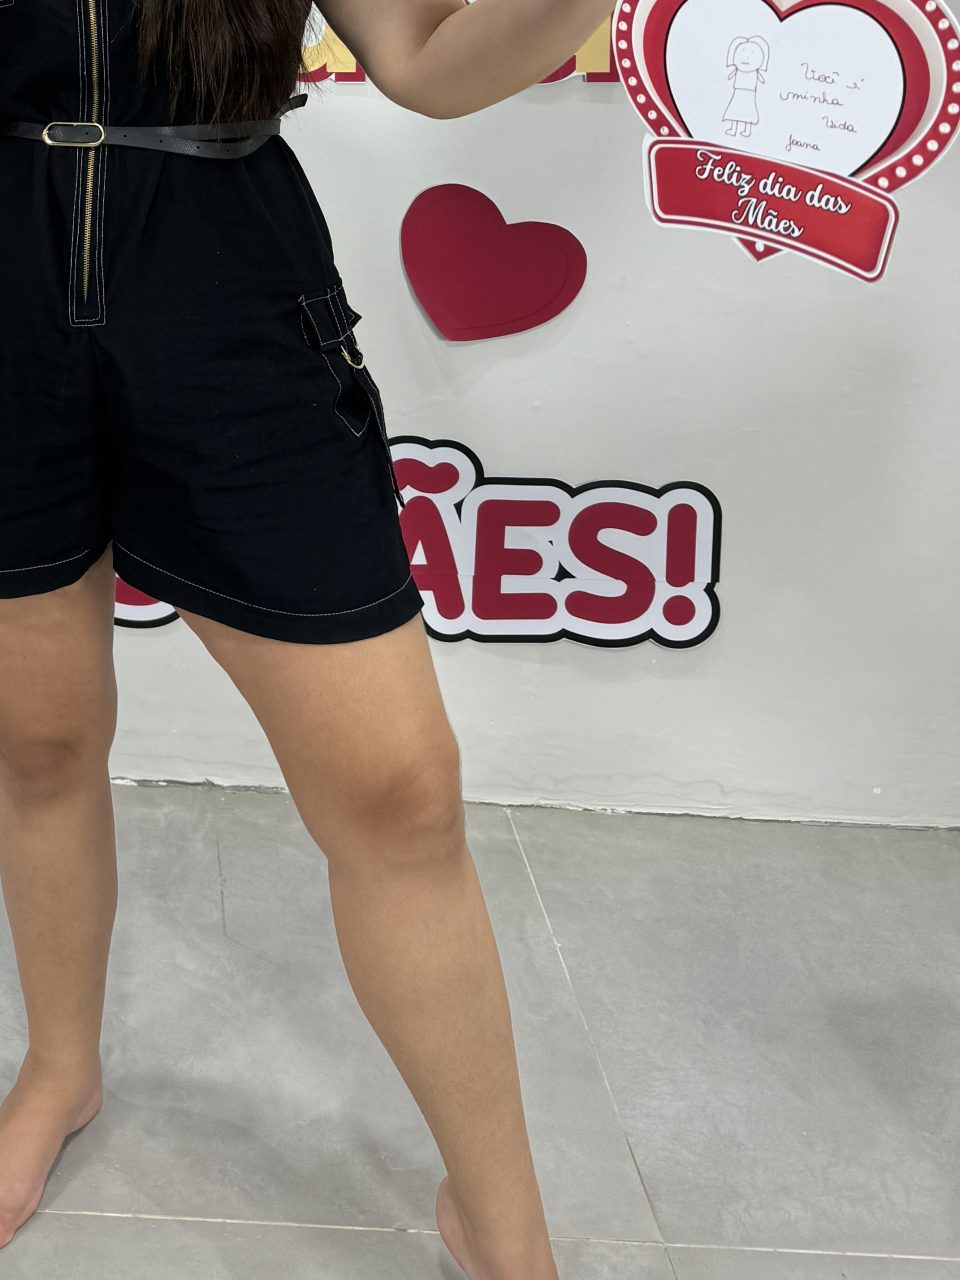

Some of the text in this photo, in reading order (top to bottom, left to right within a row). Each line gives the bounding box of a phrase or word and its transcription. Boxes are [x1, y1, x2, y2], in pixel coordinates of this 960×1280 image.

[695, 149, 851, 214] Feliz dia das
[731, 197, 804, 237] Mães
[390, 447, 710, 637] ÃES!
